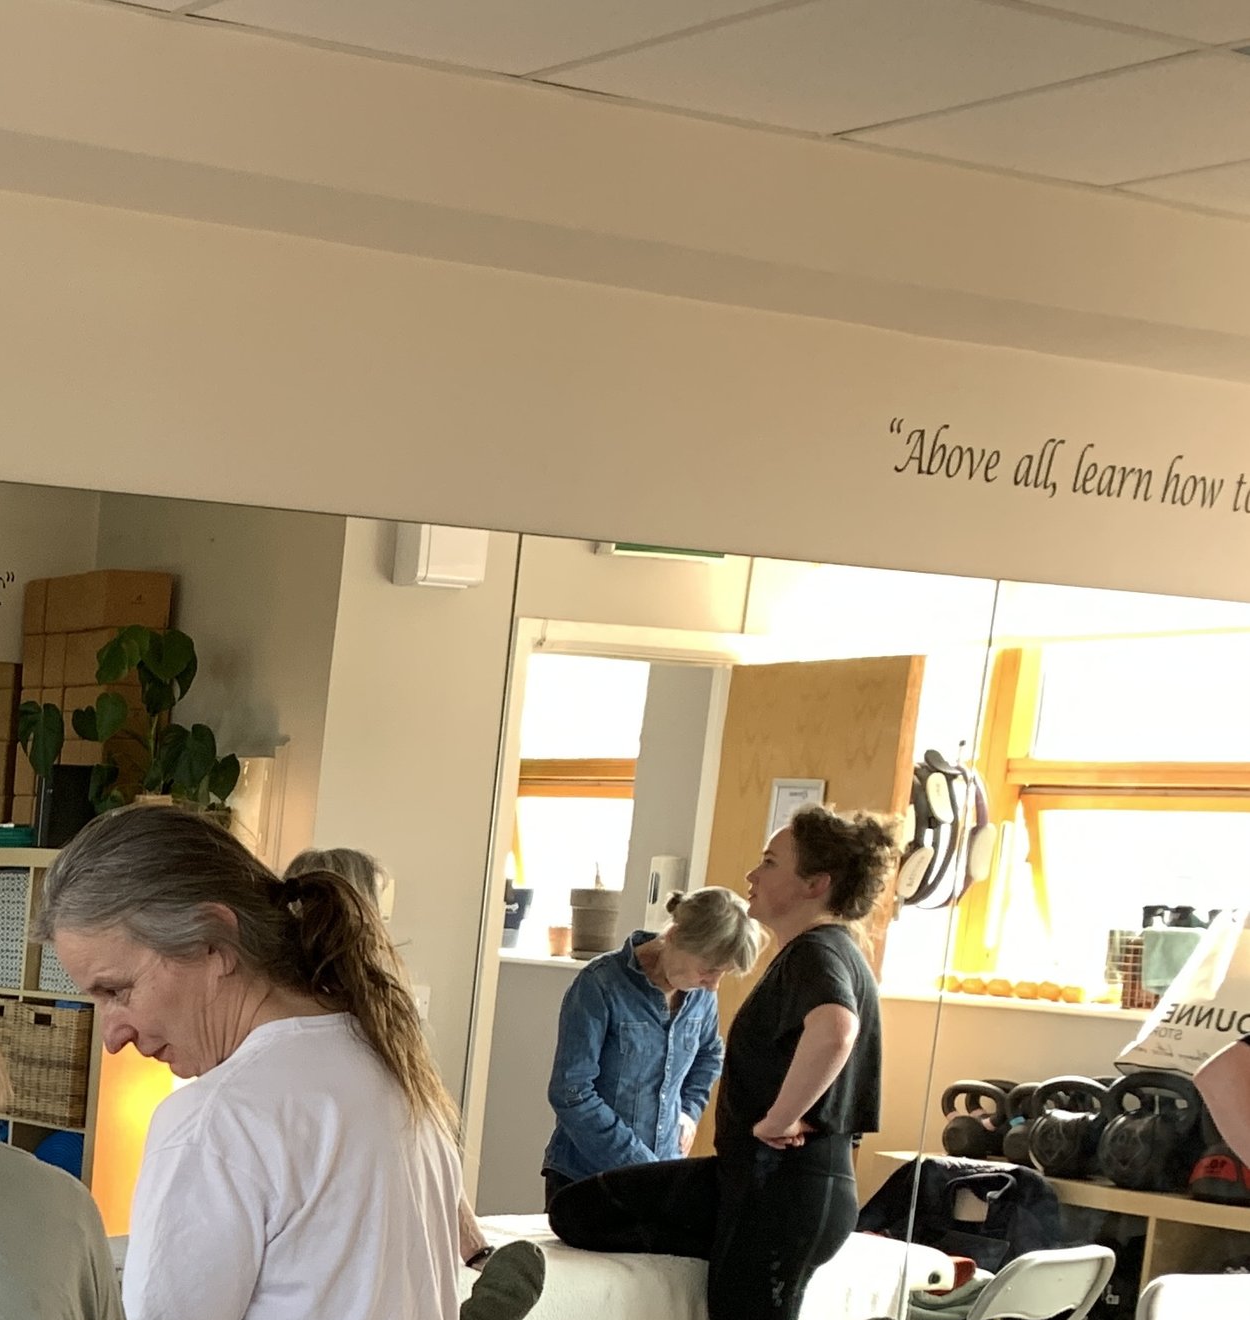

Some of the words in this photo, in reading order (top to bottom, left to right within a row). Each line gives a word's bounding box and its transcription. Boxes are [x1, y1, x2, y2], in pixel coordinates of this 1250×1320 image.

[890, 417, 1000, 483] “Above
[1013, 438, 1066, 498] all,
[1072, 443, 1152, 502] learn
[1161, 455, 1224, 509] how
